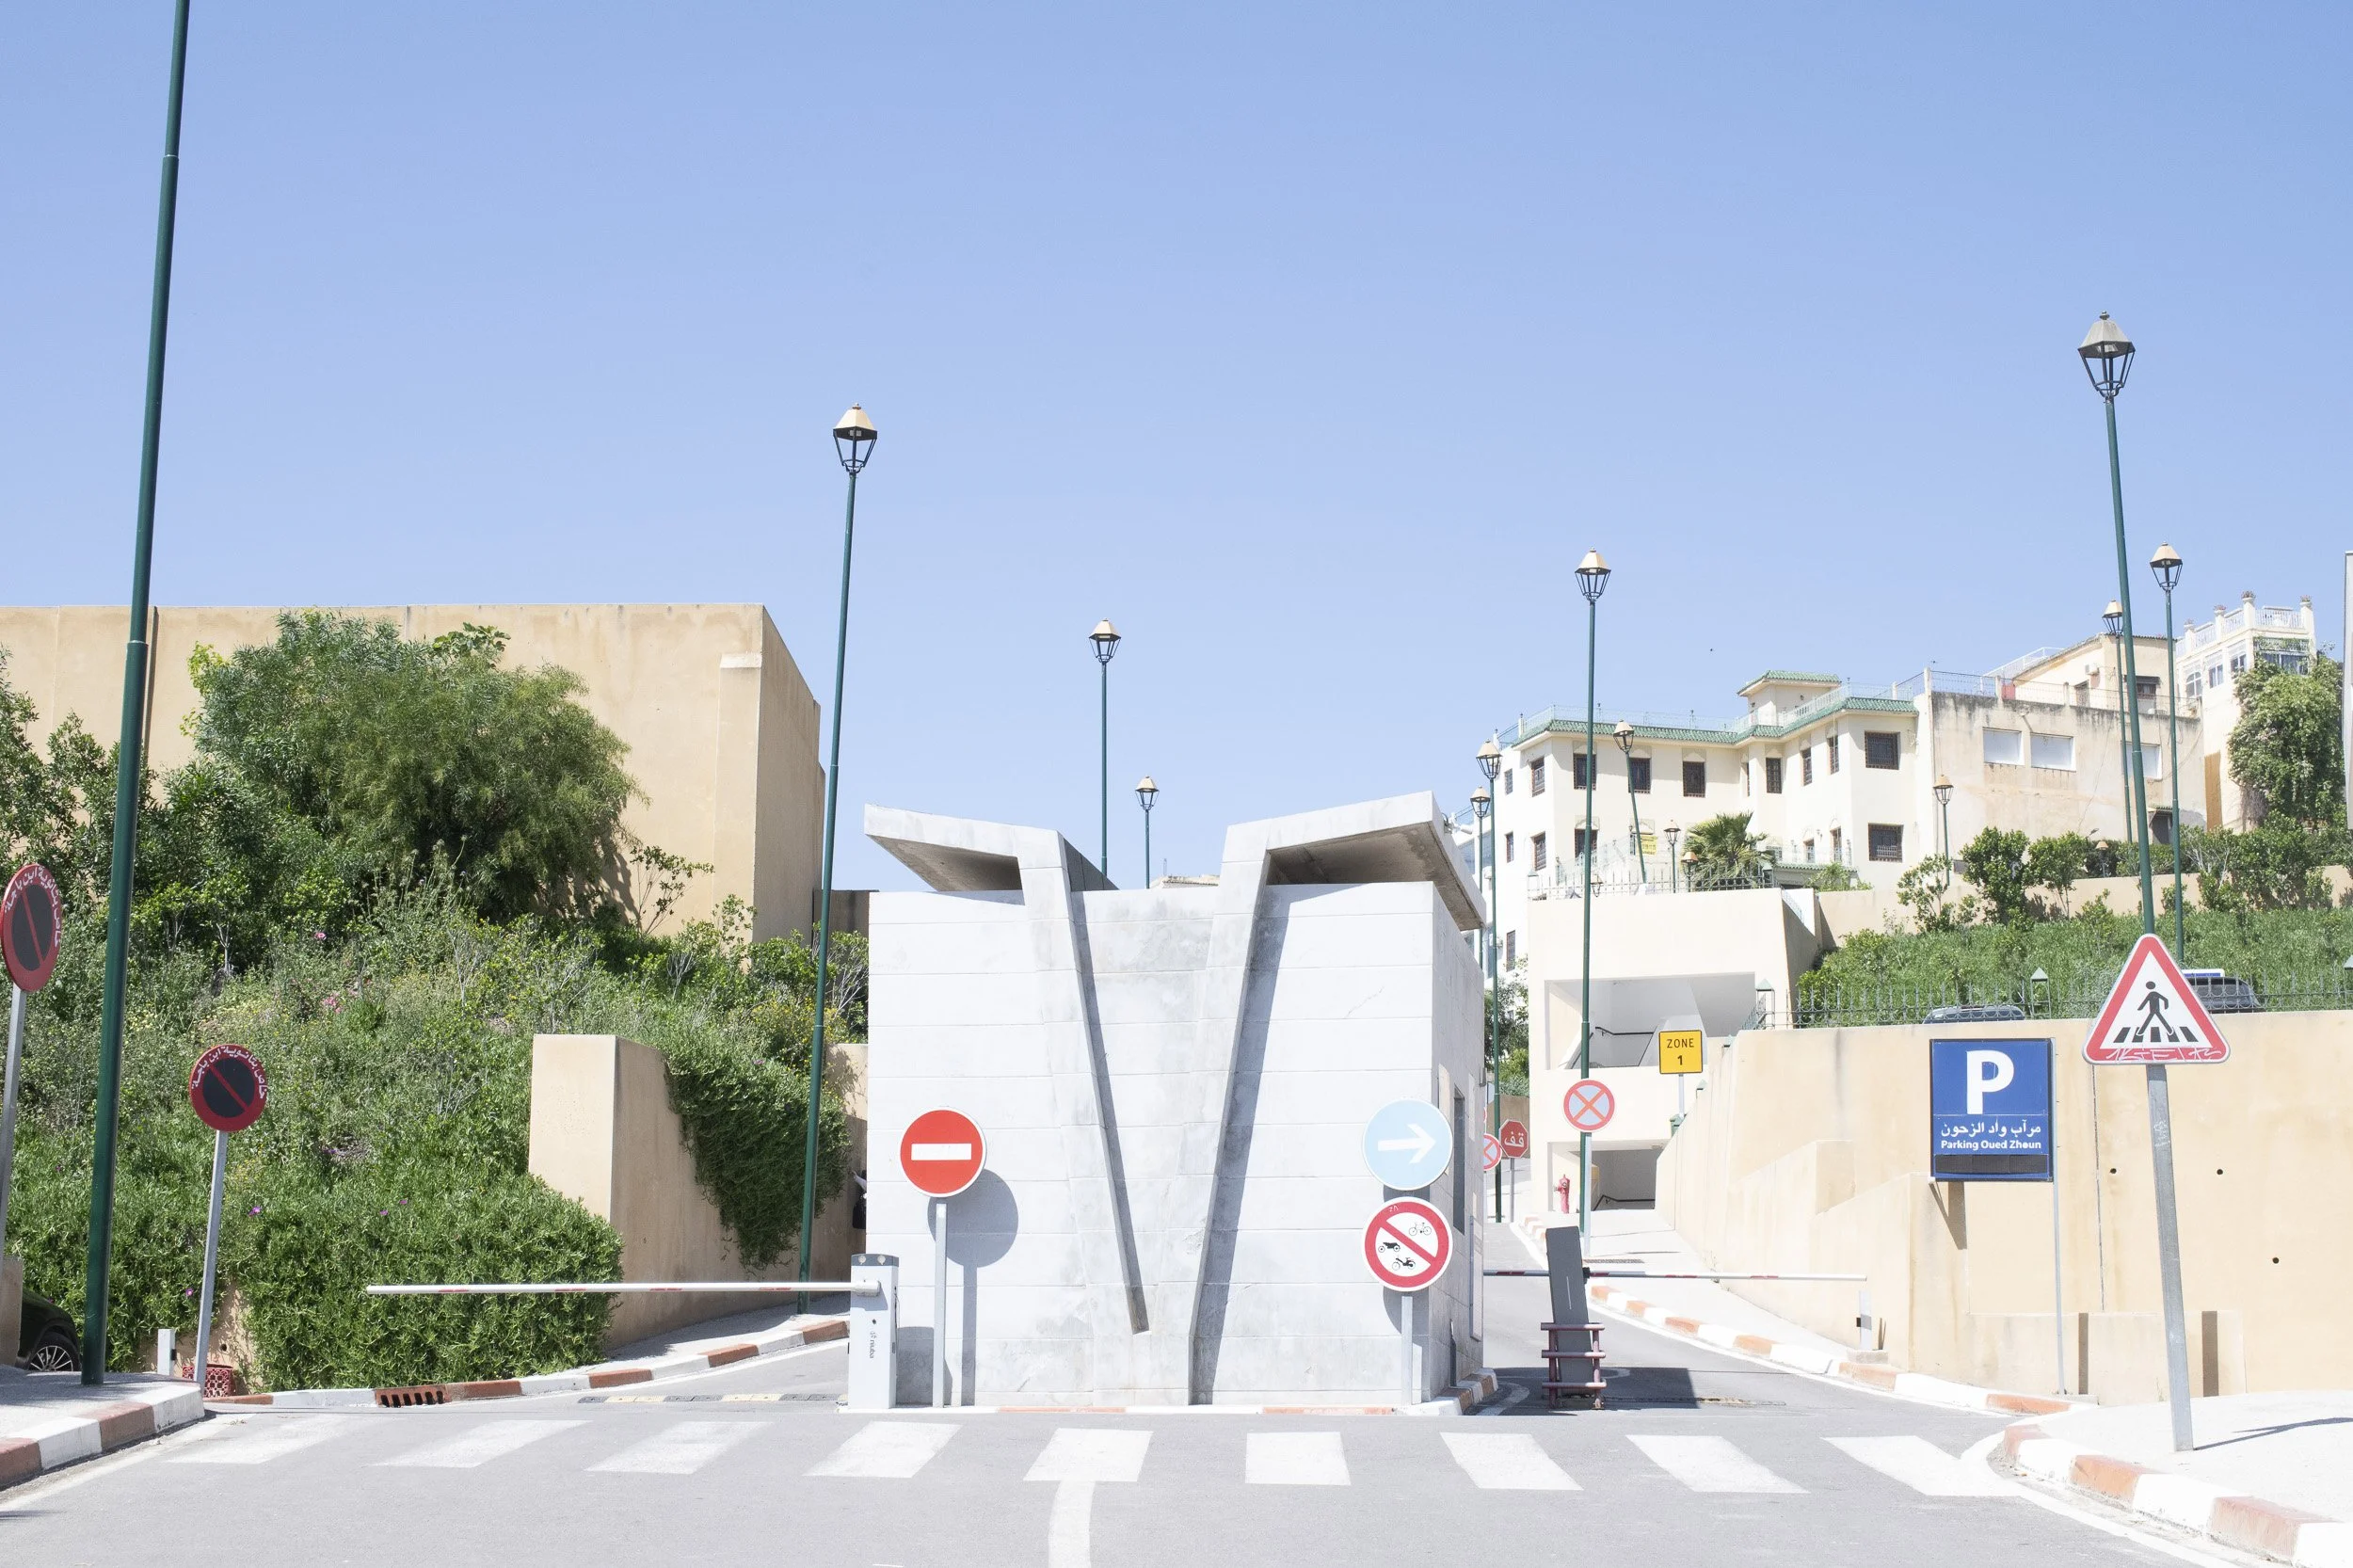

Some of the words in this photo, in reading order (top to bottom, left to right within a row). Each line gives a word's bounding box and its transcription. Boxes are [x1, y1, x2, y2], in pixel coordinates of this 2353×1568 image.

[23, 867, 38, 885] ابن
[1667, 1038, 1694, 1048] ZONE
[209, 1048, 221, 1063] ابن
[1677, 1055, 1683, 1065] 1
[191, 1060, 210, 1089] باجة
[1966, 1049, 2014, 1114] P
[254, 1069, 268, 1098] خاص
[1941, 1120, 1985, 1137] الزحون
[1988, 1118, 2007, 1137] واد
[2010, 1119, 2041, 1137] مرآب
[1504, 1131, 1524, 1147] قف
[1941, 1140, 1978, 1151] Parking
[1980, 1140, 2007, 1149] Oued
